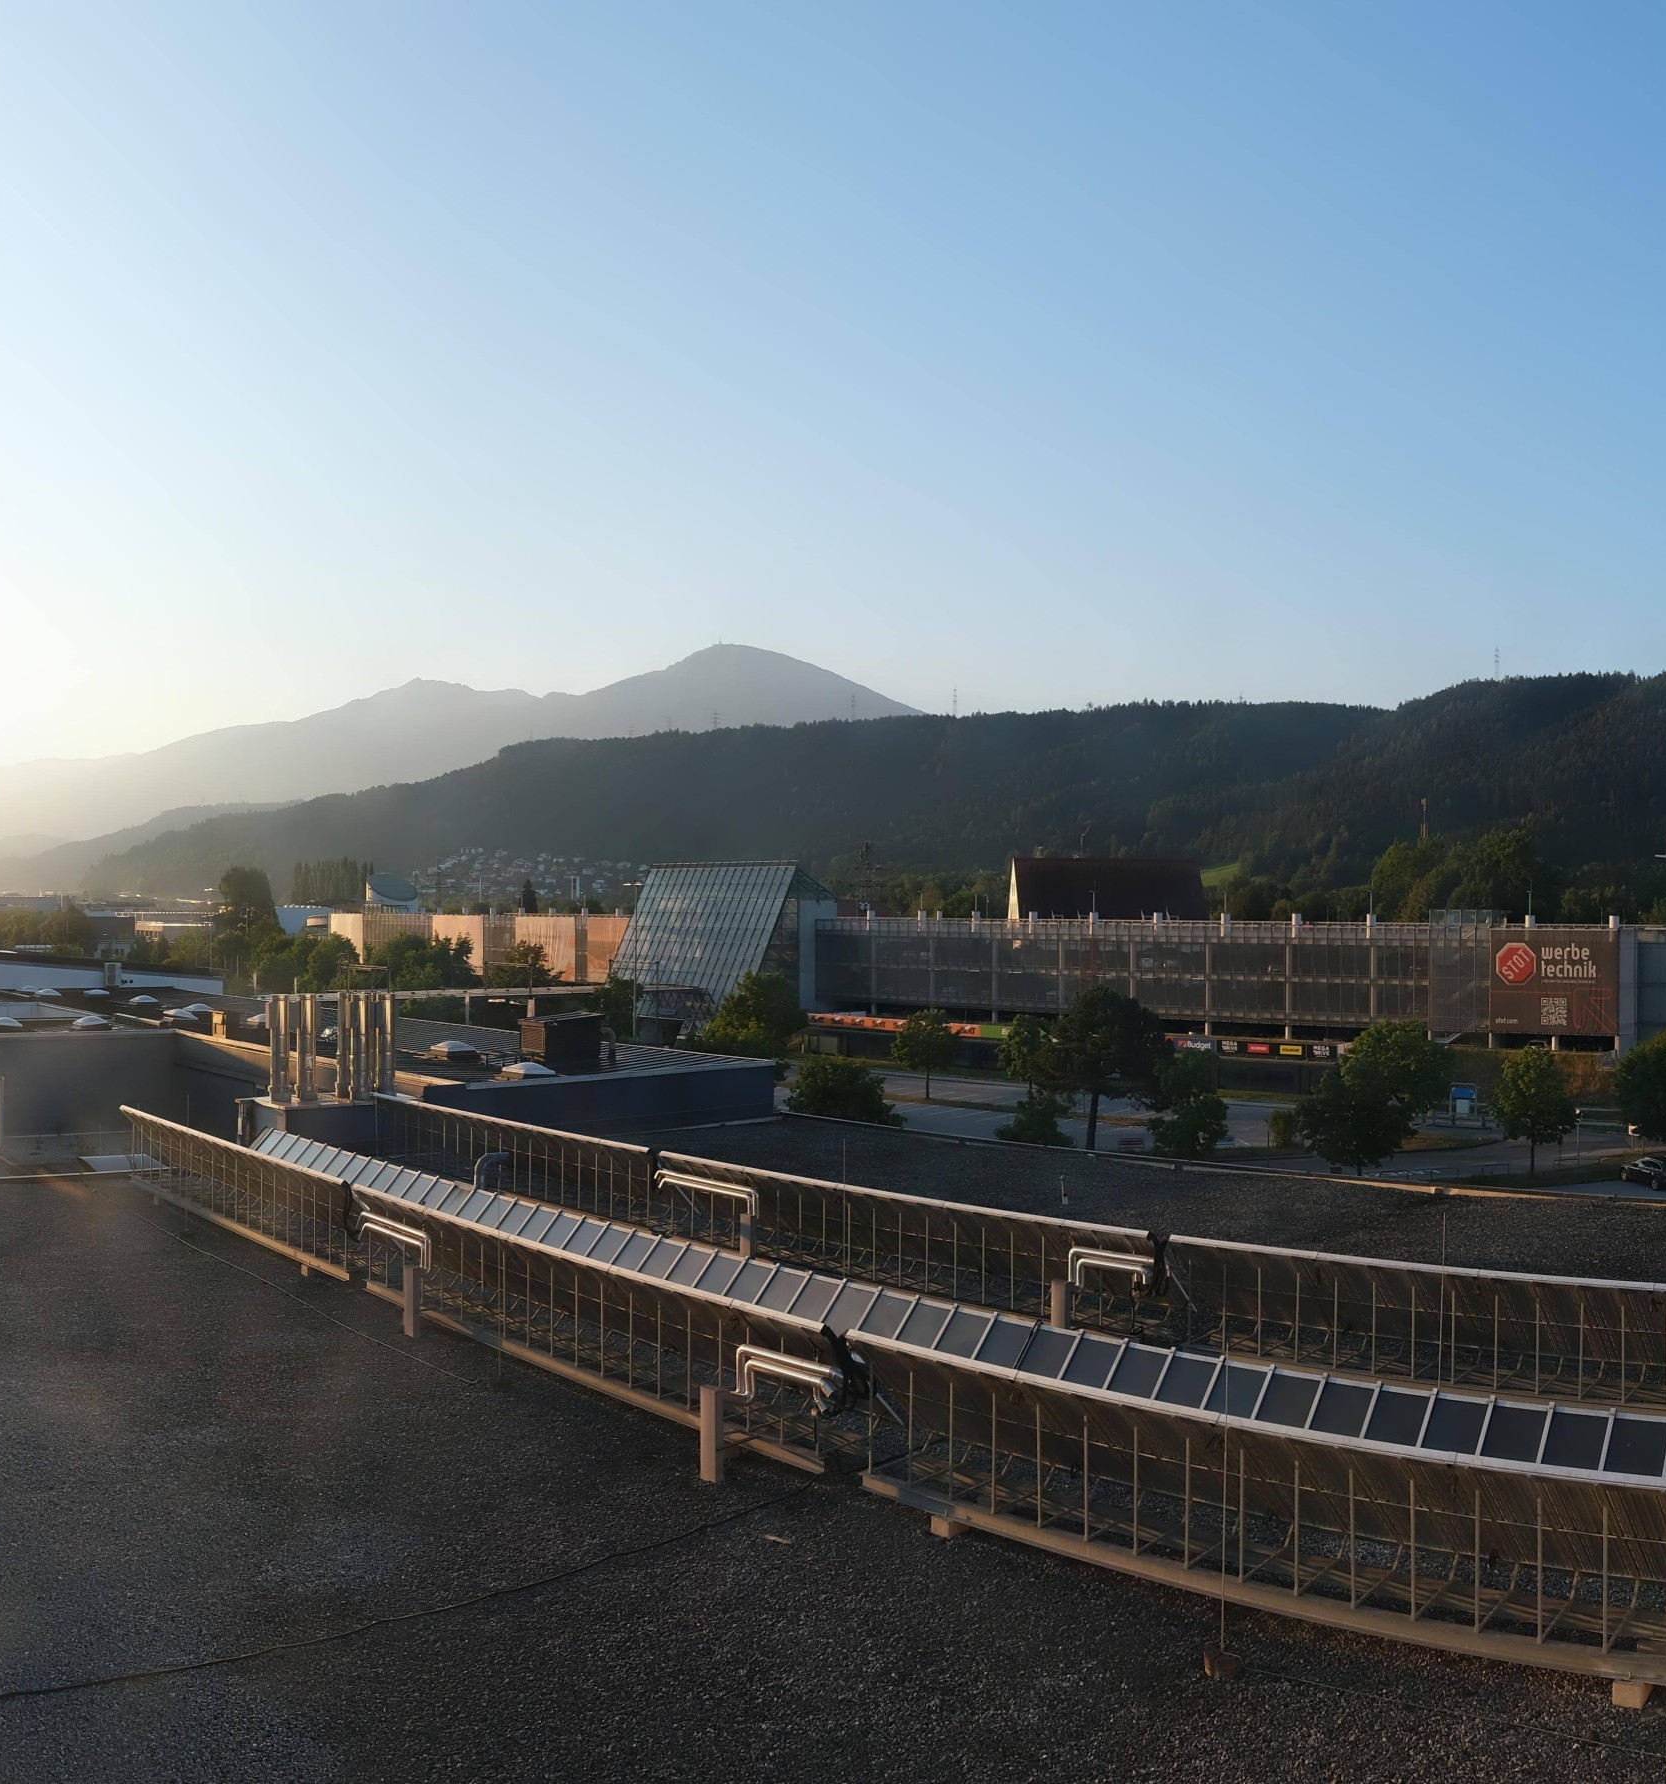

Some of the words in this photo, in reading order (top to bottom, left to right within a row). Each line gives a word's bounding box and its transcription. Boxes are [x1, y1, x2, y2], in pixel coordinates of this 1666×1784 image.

[1541, 943, 1590, 960] werbe
[1501, 948, 1531, 980] STOT
[1541, 960, 1597, 978] technik
[1495, 1017, 1519, 1025] stot.com
[1187, 1040, 1212, 1051] Budget
